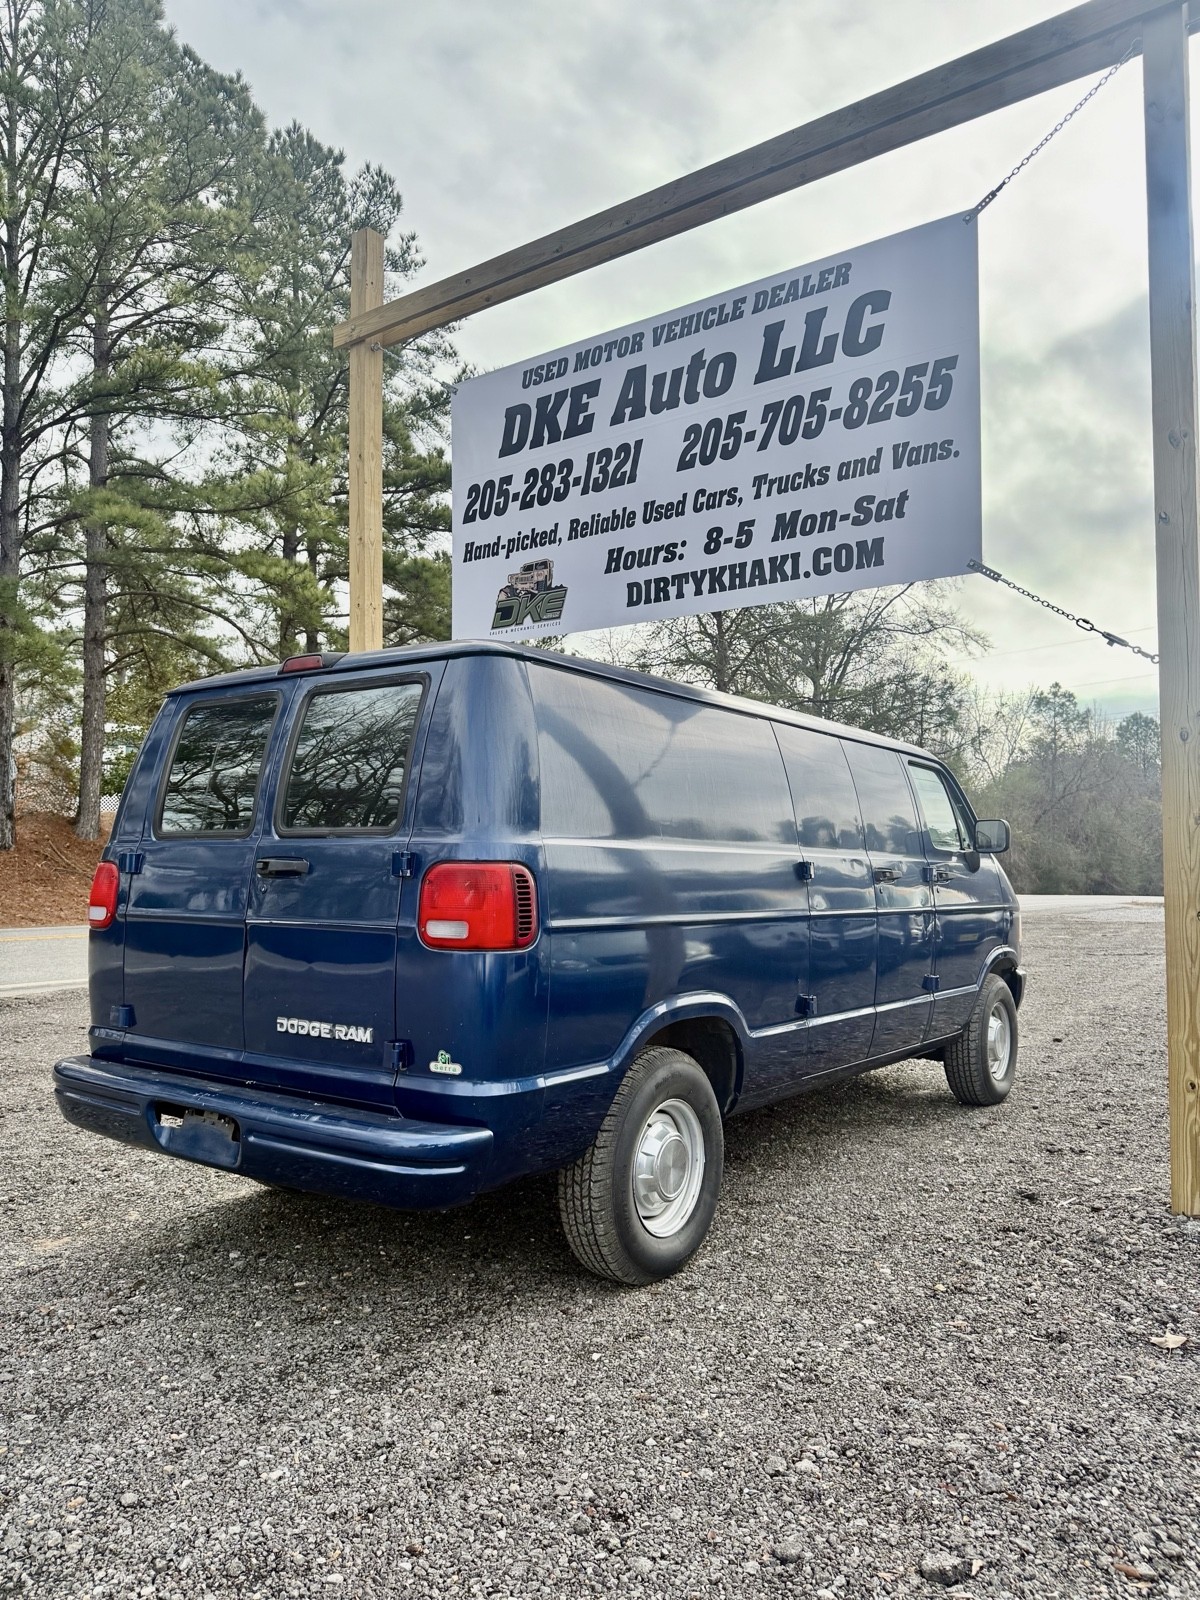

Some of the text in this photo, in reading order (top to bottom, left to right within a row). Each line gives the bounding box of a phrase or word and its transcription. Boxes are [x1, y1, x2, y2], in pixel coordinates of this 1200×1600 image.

[522, 262, 853, 389] USED MOTOR VEHICLE DEALER
[498, 289, 892, 458] DKE Auto LLC
[675, 354, 959, 473] 205-705-8255
[462, 439, 644, 526] 205-283-1321
[462, 438, 961, 564] Hand-picked, Reliable Used Cars, Trucks and Vans.
[604, 489, 911, 575] Hours: 8-5 Mon-Sat
[626, 537, 886, 608] DIRTYKHAKI.COM
[491, 588, 568, 630] DKE
[276, 1016, 373, 1043] DODGE RAM
